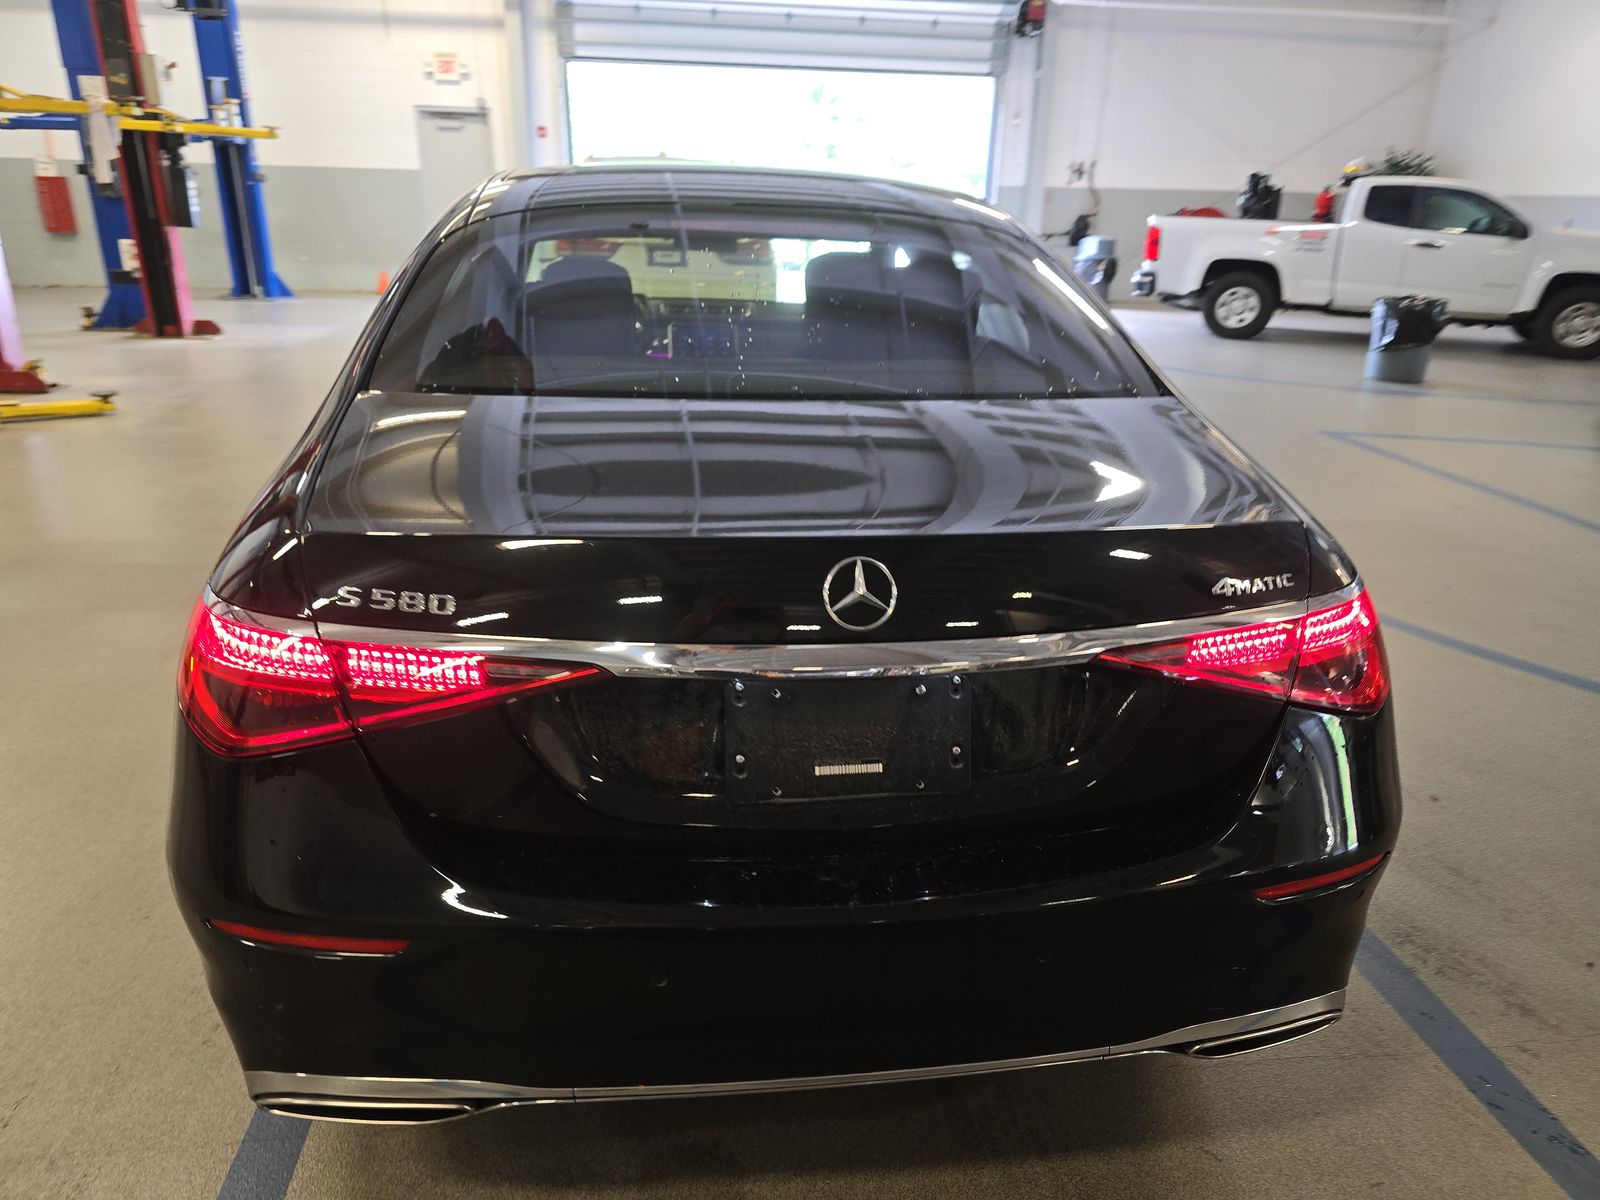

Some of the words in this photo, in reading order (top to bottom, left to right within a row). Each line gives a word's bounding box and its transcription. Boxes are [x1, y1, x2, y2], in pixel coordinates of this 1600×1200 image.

[1211, 573, 1295, 597] 4MATIC
[335, 585, 363, 608] S
[369, 588, 457, 615] 580
